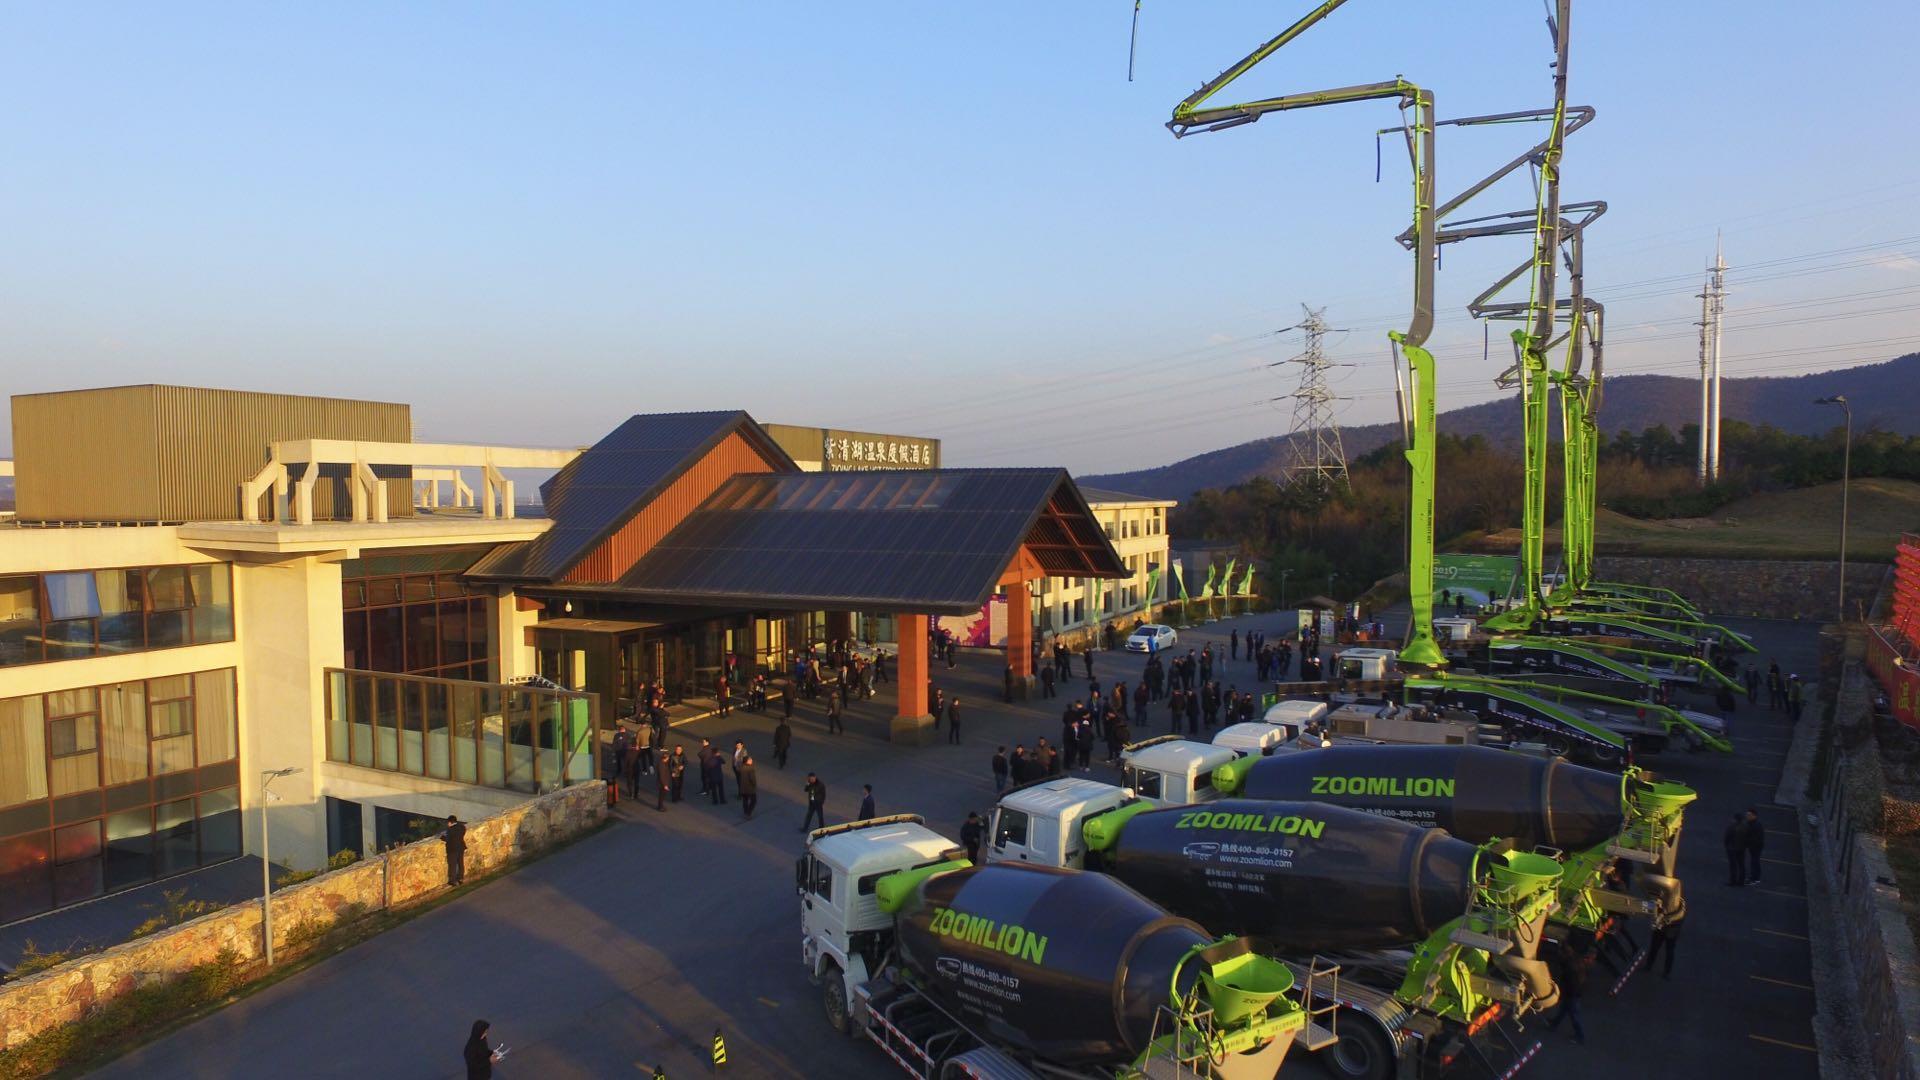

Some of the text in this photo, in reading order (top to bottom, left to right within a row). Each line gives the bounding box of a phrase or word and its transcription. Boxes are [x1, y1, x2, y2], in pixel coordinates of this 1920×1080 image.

[1311, 777, 1456, 798] ZOOMLION
[1175, 811, 1326, 839] ZOOMLION
[1219, 855, 1293, 869] www.zoomlion.com
[928, 907, 1048, 965] ZOOMLION
